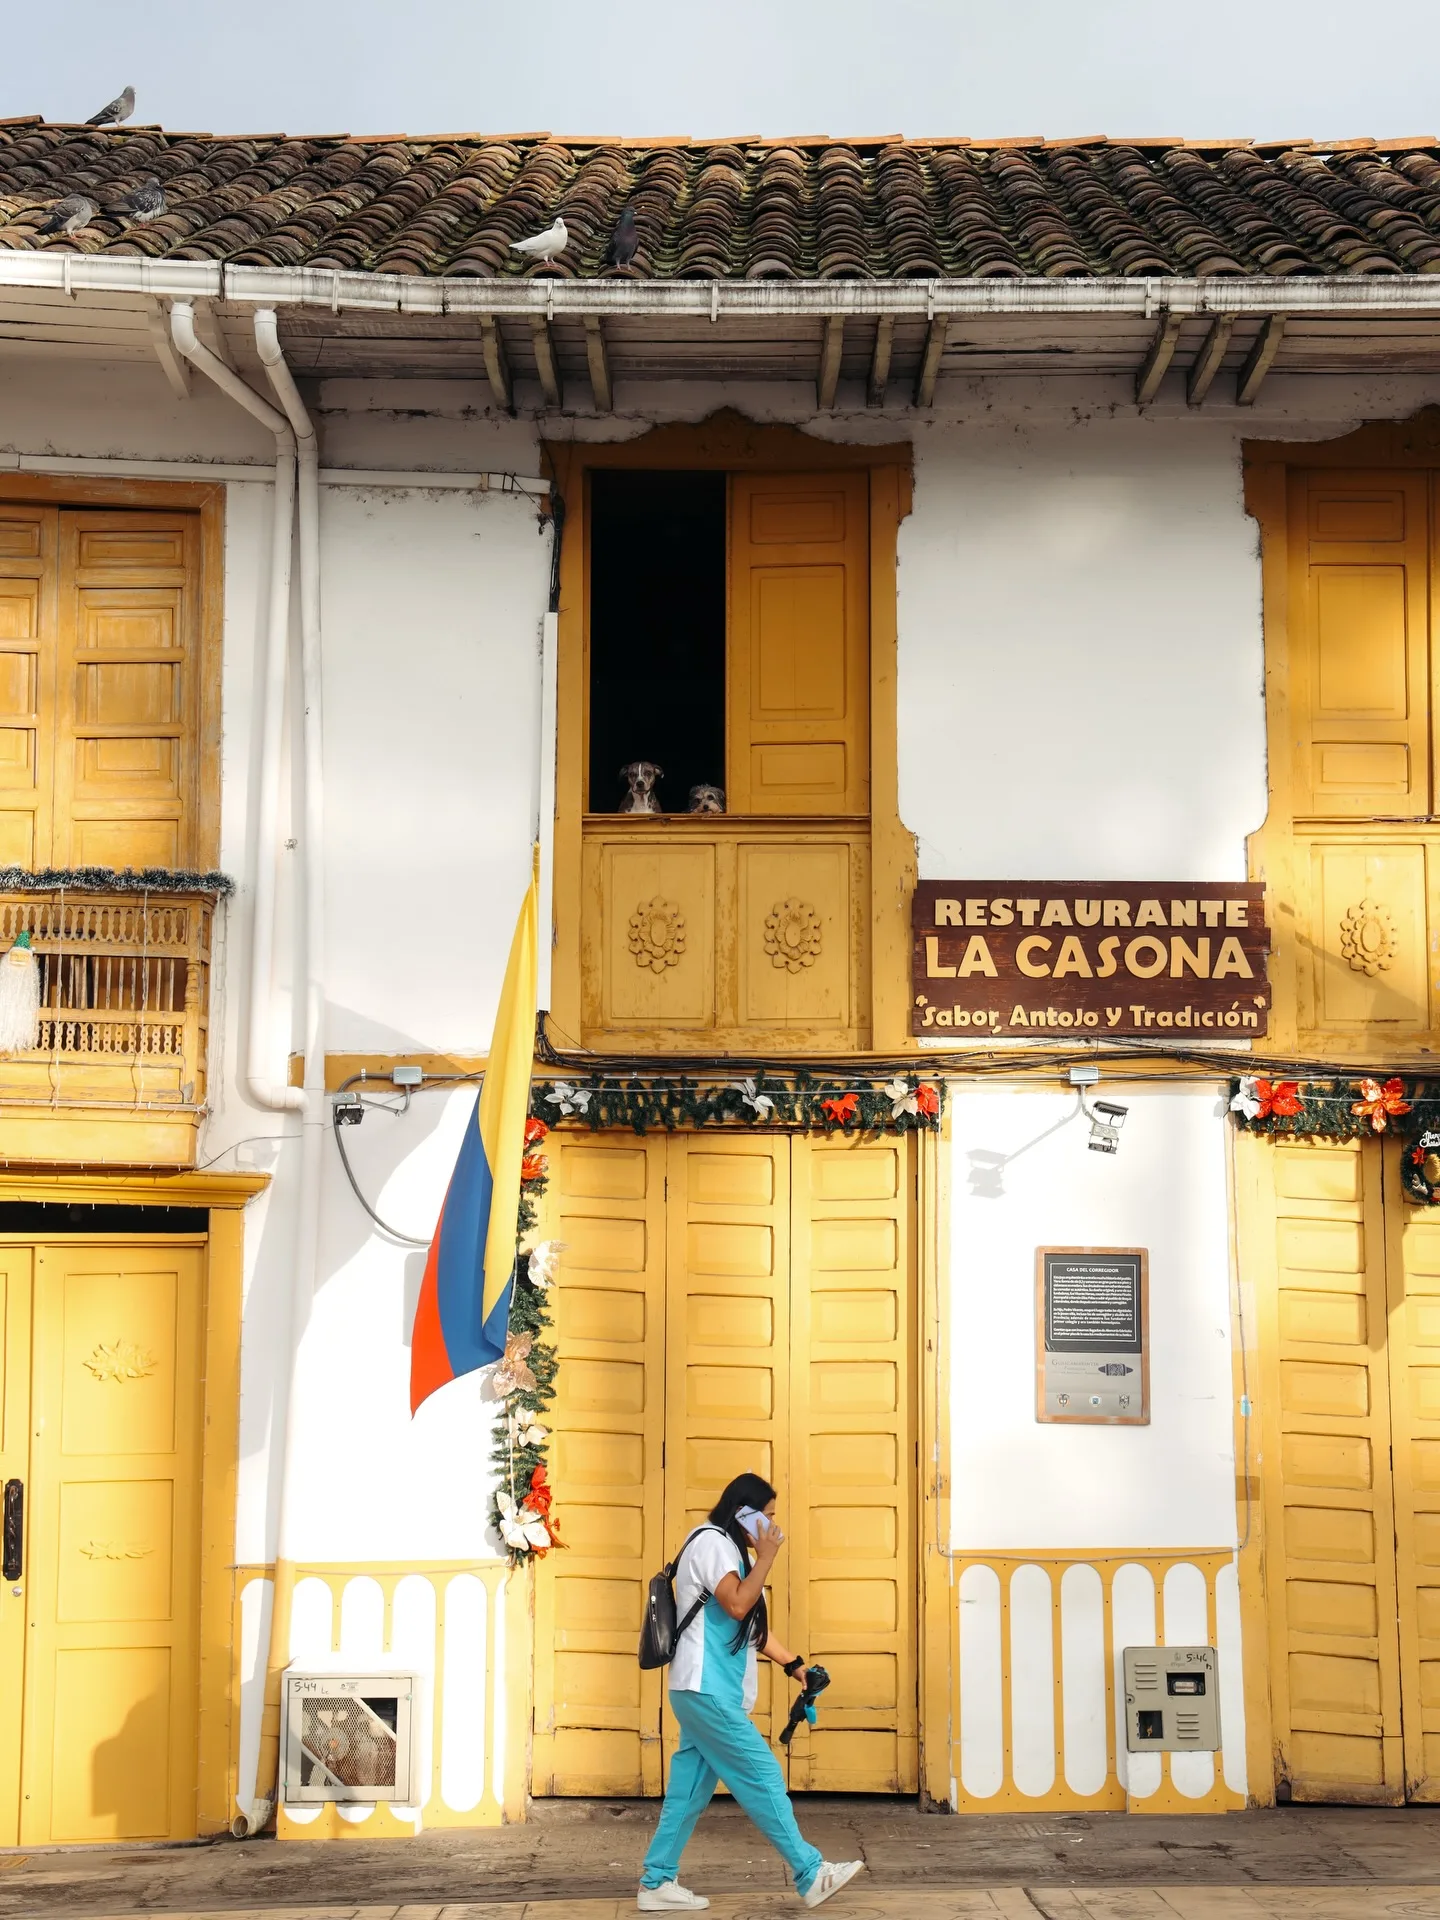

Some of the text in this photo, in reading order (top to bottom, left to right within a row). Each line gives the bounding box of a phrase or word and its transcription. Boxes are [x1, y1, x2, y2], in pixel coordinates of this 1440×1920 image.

[934, 898, 1249, 927] RESTAURANTE
[925, 935, 1254, 979] LA CASONA
[1106, 1007, 1122, 1026] y
